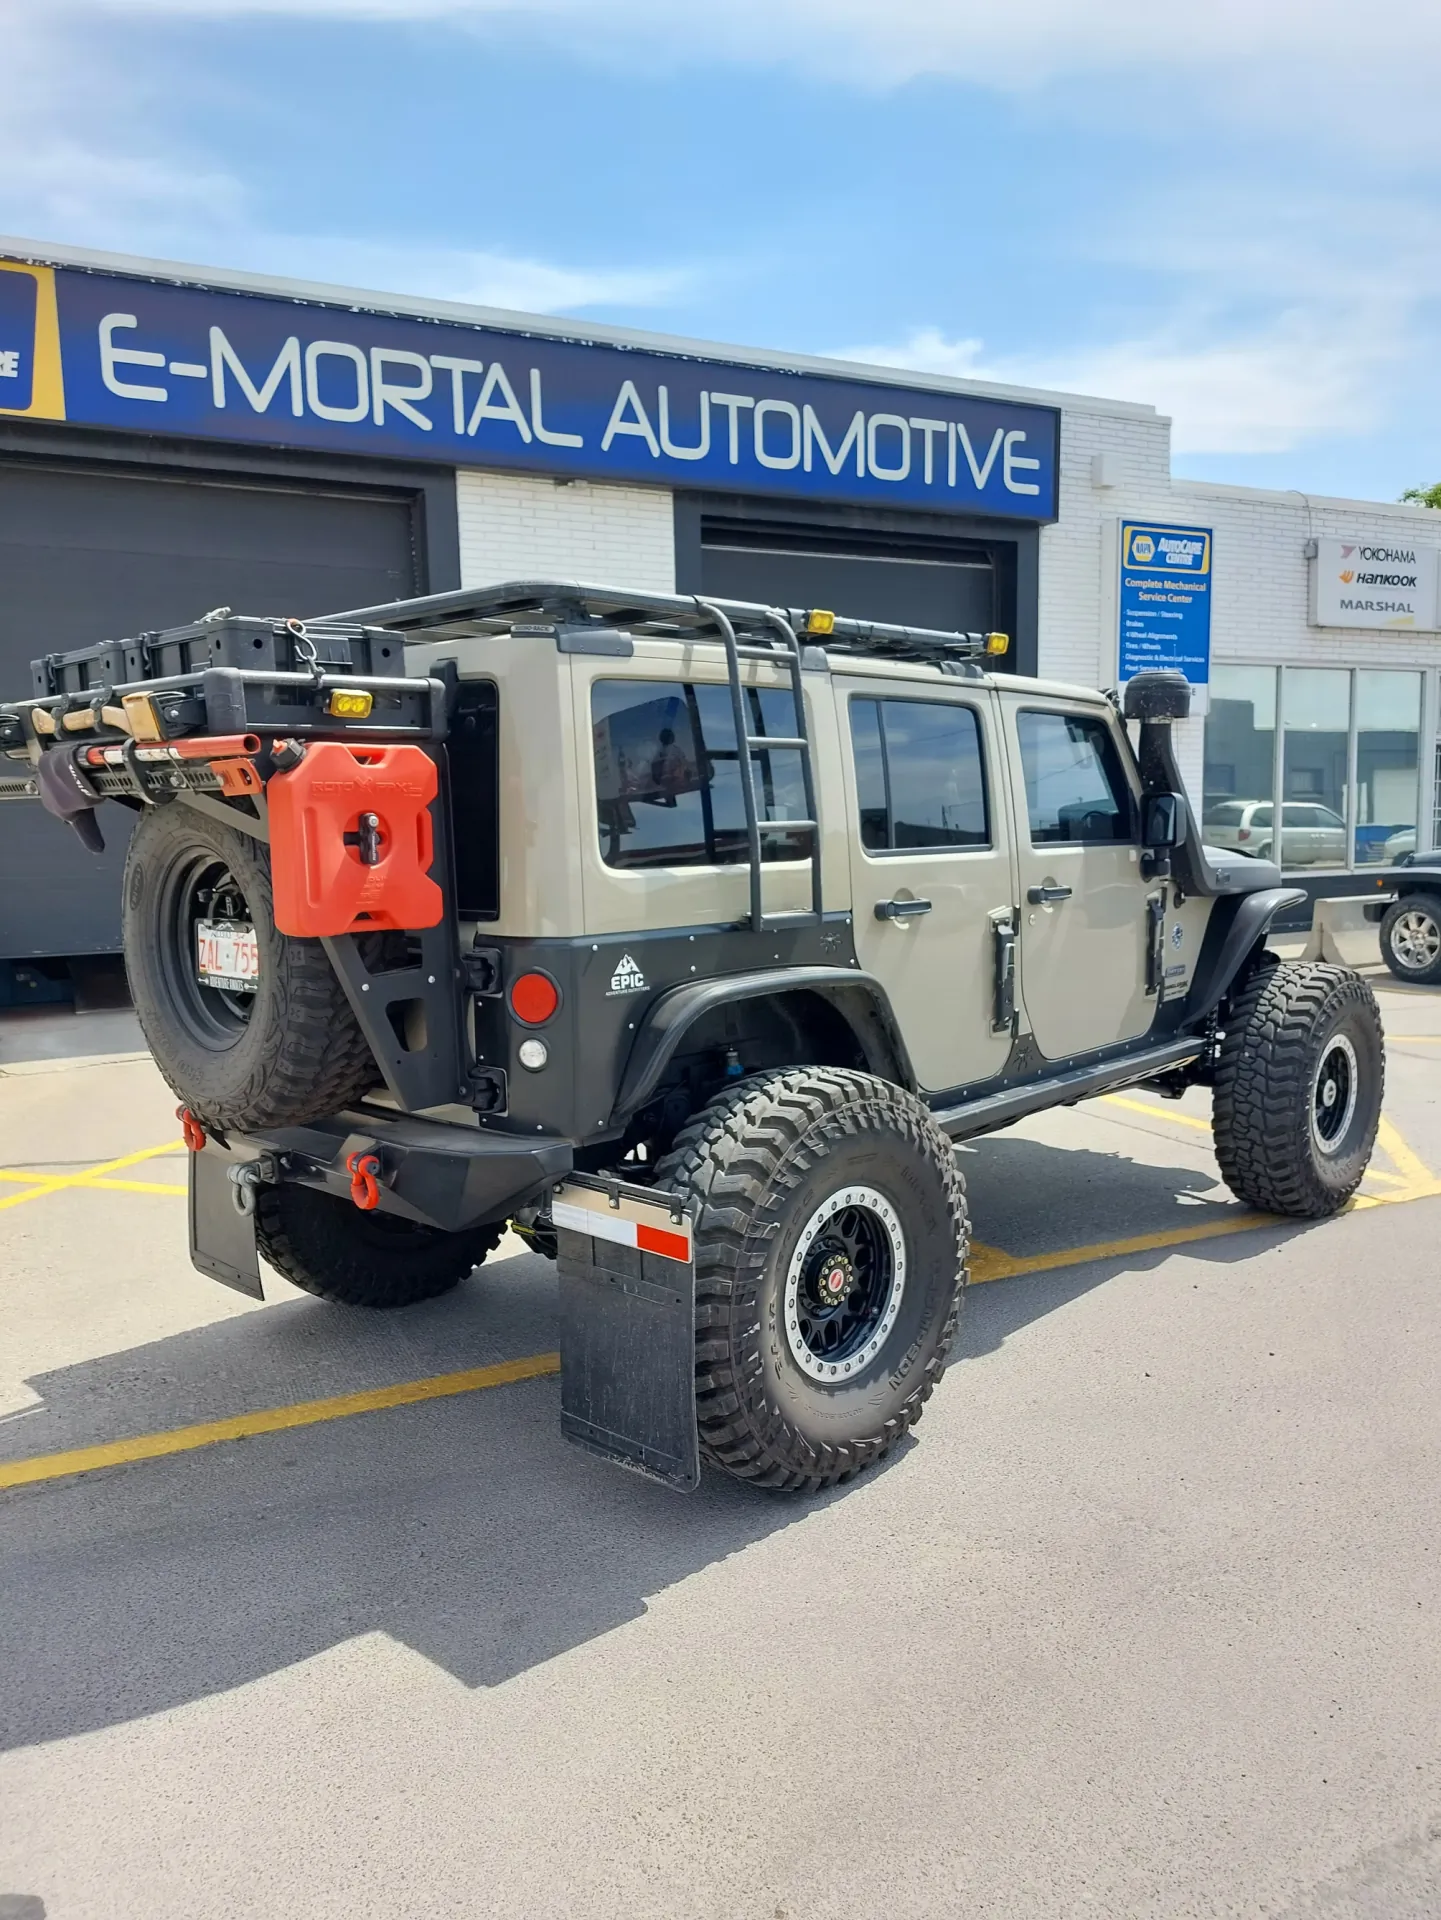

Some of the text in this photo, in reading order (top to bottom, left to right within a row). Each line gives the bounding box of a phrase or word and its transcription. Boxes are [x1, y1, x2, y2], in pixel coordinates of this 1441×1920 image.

[99, 313, 1040, 495] E-MORTAL AUTOMOTIVE
[1358, 546, 1416, 564] YOKOHAMA
[1125, 578, 1206, 591] Complete Mechanical
[1138, 591, 1167, 601] Service
[1340, 599, 1414, 613] MARSHAL
[199, 940, 222, 970] ZAL
[611, 973, 644, 990] EPIC
